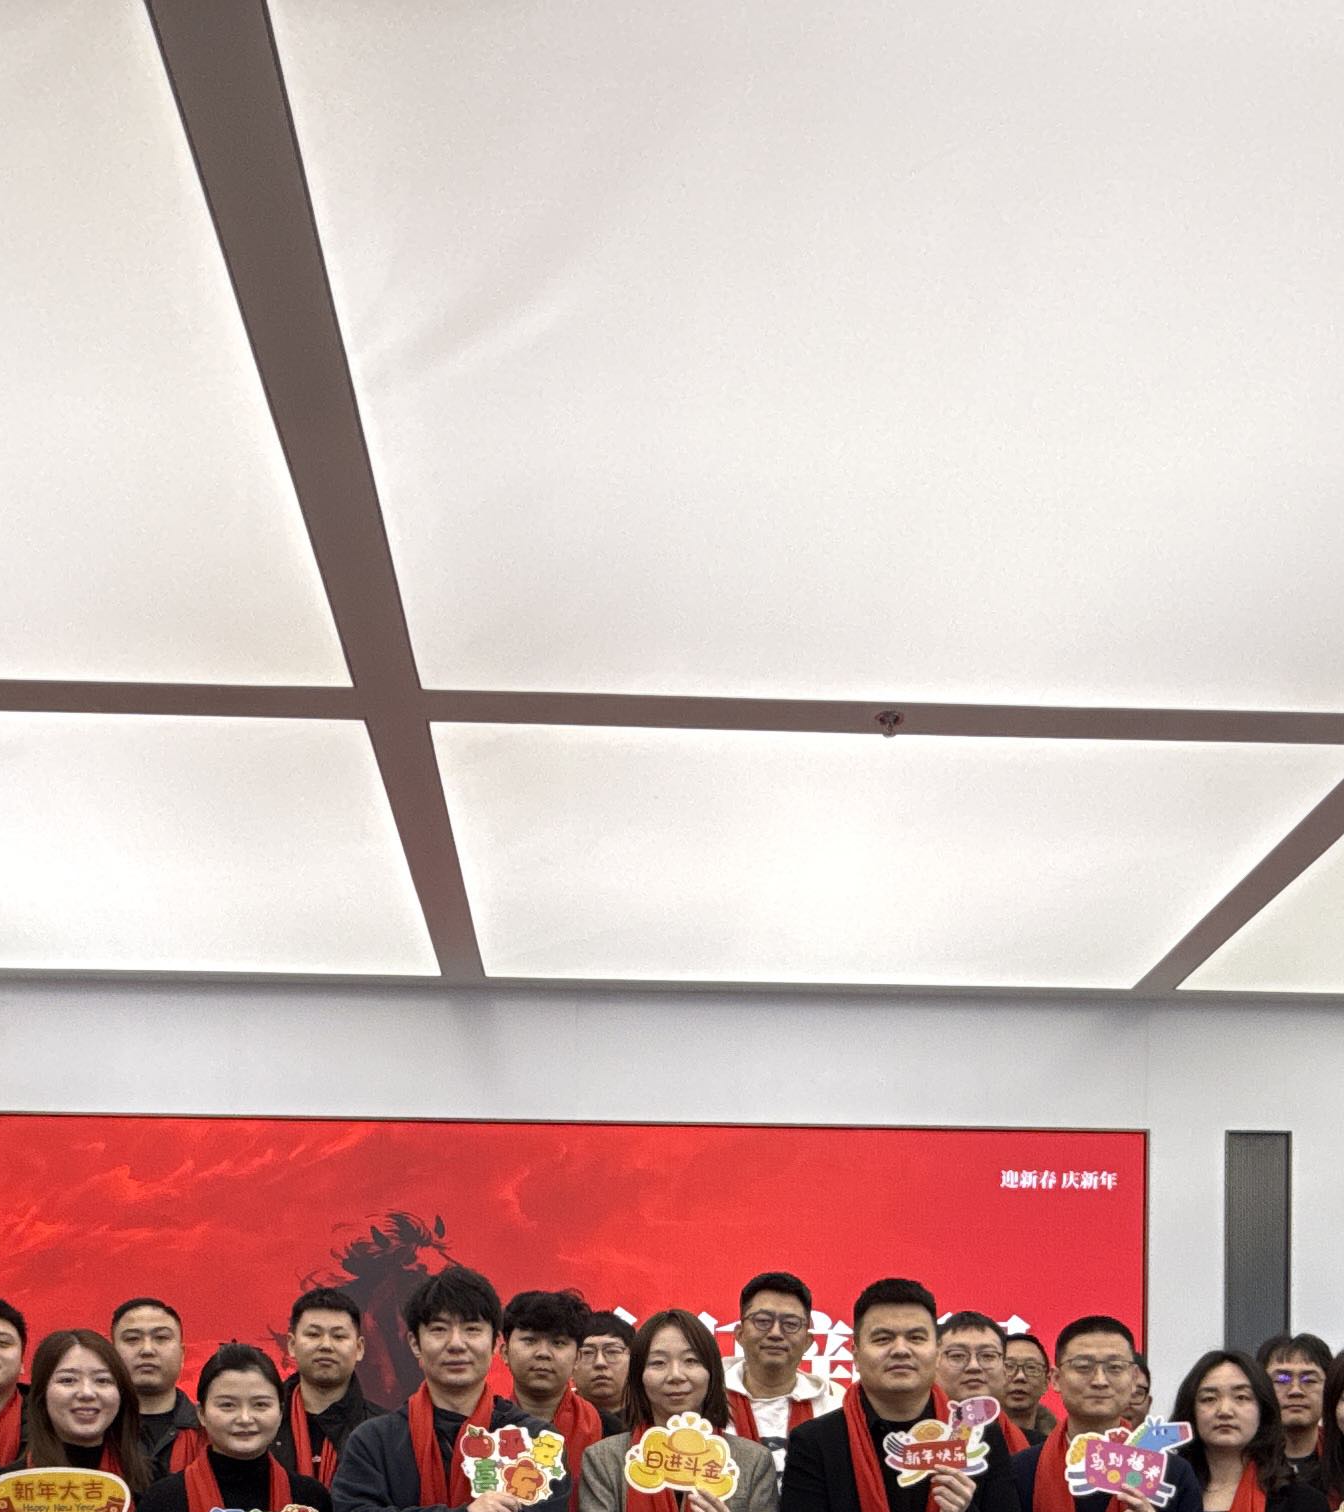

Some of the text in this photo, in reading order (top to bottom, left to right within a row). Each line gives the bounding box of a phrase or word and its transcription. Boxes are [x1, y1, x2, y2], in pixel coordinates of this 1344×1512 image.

[1000, 1170, 1118, 1190] 迎新春 庆新年
[647, 1451, 722, 1479] 日进斗金
[904, 1447, 967, 1465] 新年快乐
[12, 1480, 105, 1501] 新年大吉
[23, 1504, 96, 1512] Happy New Year
